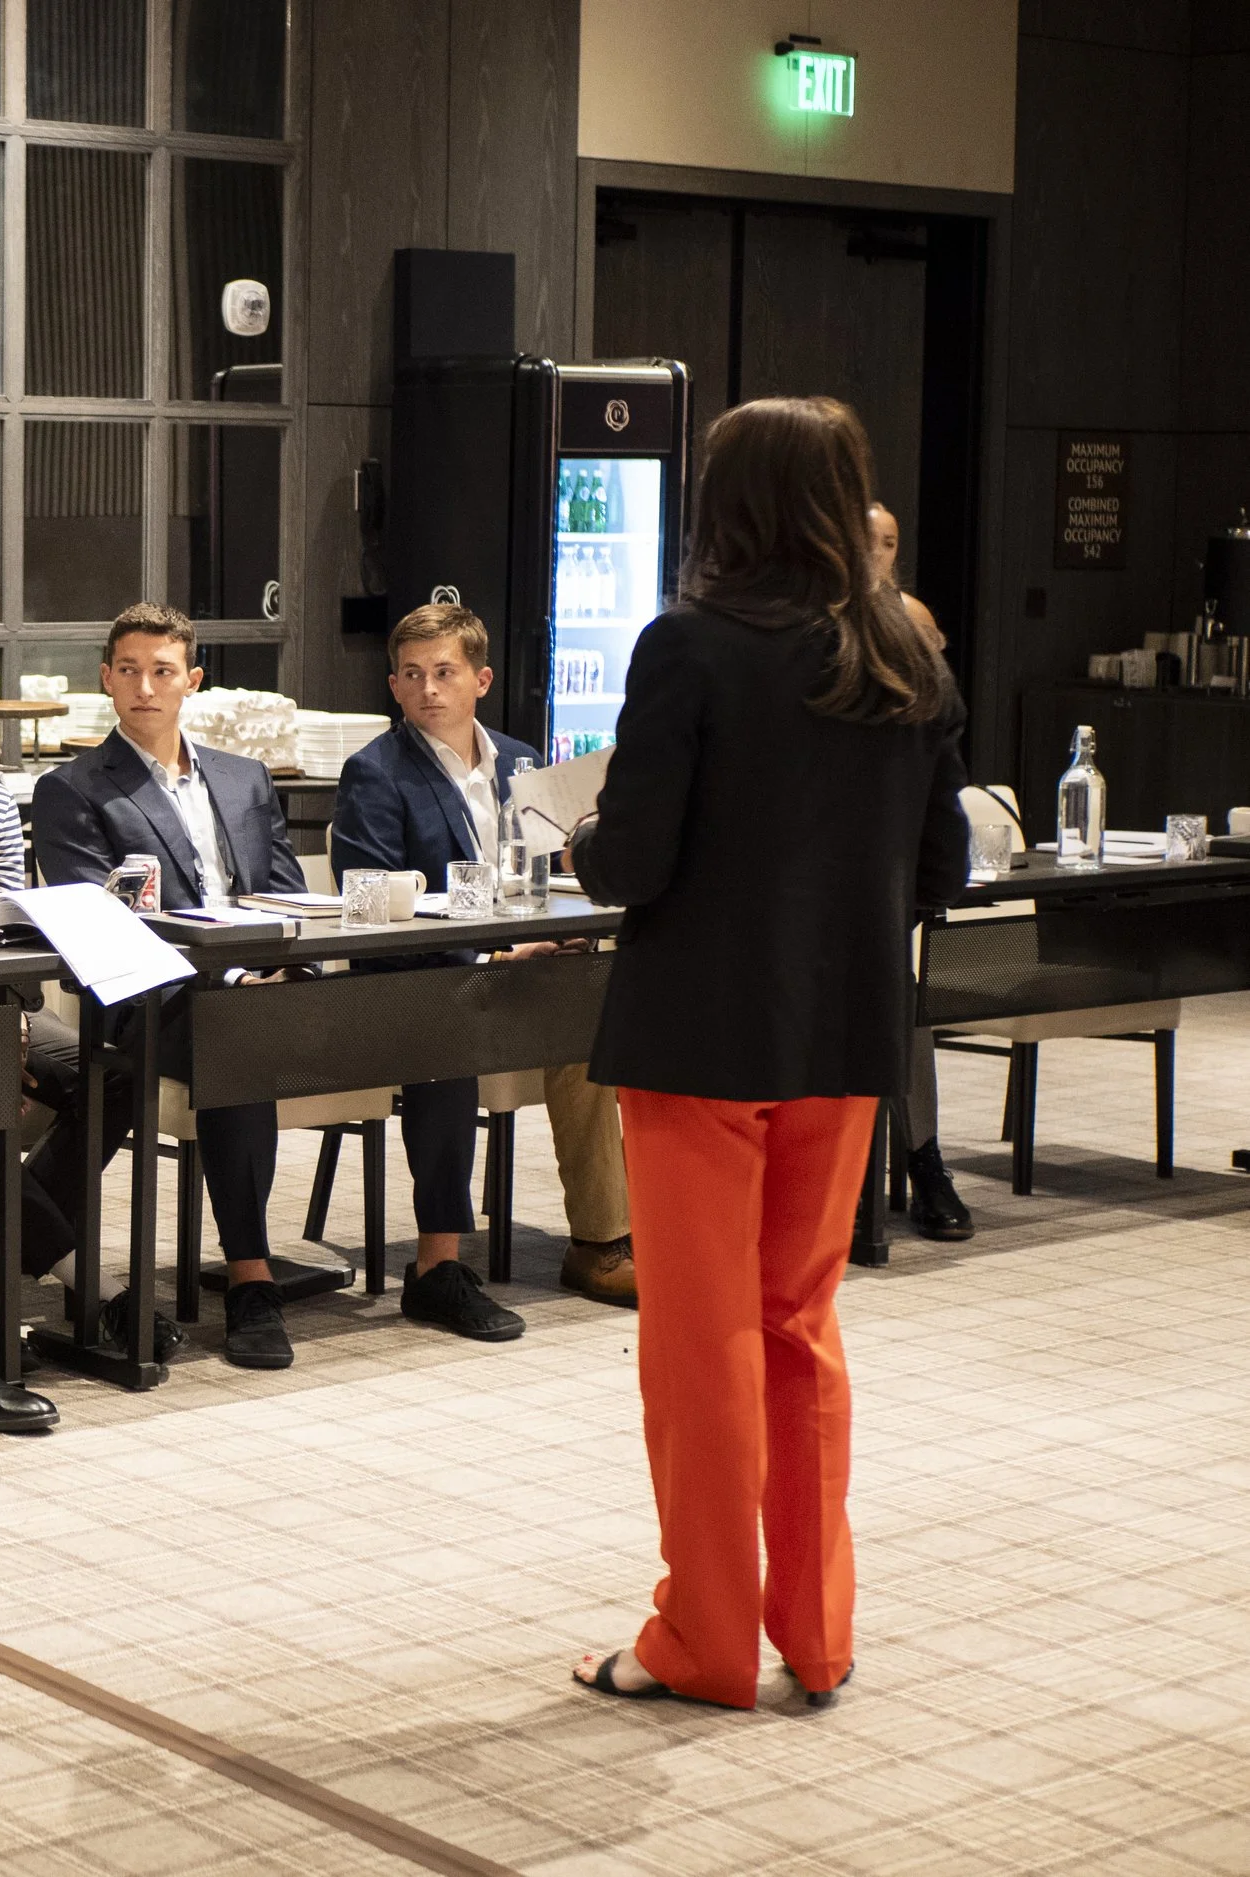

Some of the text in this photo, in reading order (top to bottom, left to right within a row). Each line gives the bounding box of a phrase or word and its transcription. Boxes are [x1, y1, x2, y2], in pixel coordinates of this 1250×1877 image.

[798, 55, 847, 112] EXIT
[1071, 443, 1120, 457] MAXIMUM
[1066, 457, 1124, 473] OCCUPANCY
[1086, 475, 1104, 489] 156
[1068, 496, 1119, 512] COMBINED
[1069, 513, 1118, 527] MAXIMUM
[1064, 528, 1122, 543] OCCUPANCY
[1083, 544, 1101, 559] 542
